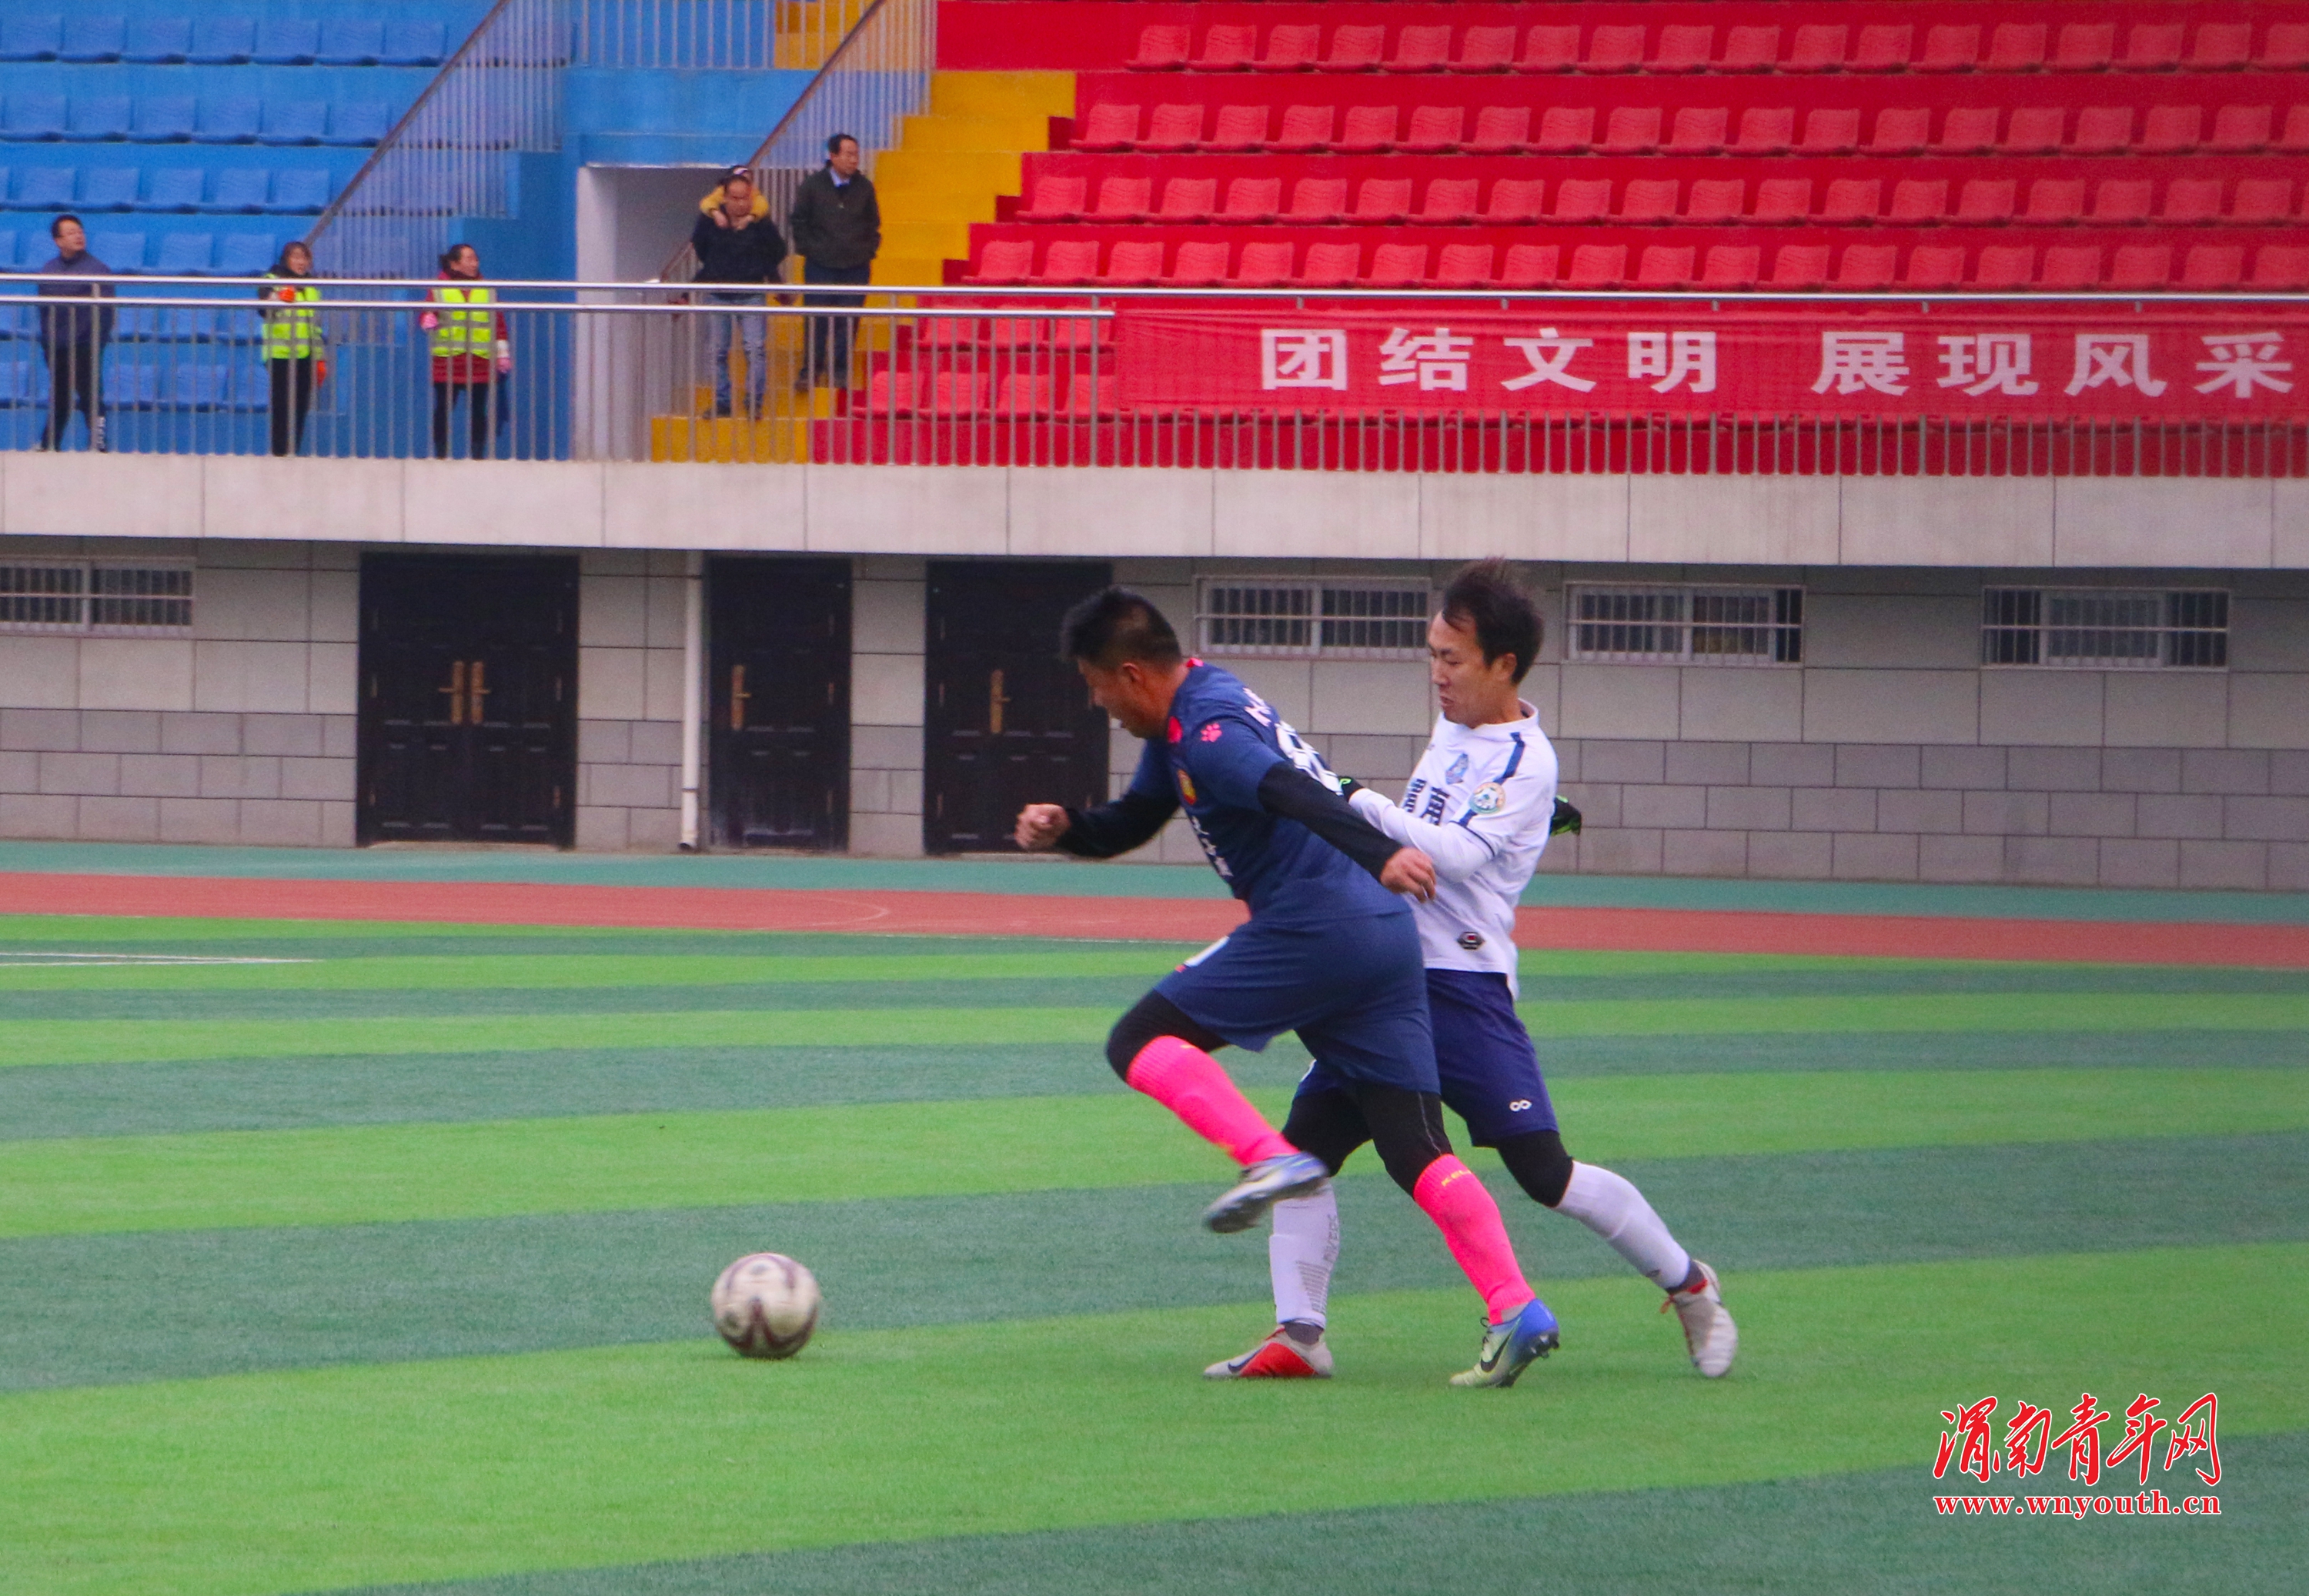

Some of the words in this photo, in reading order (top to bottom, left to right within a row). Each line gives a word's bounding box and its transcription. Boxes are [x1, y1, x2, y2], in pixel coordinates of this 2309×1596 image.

[1261, 327, 1717, 393] 团结文明
[1811, 331, 2294, 398] 展现风采
